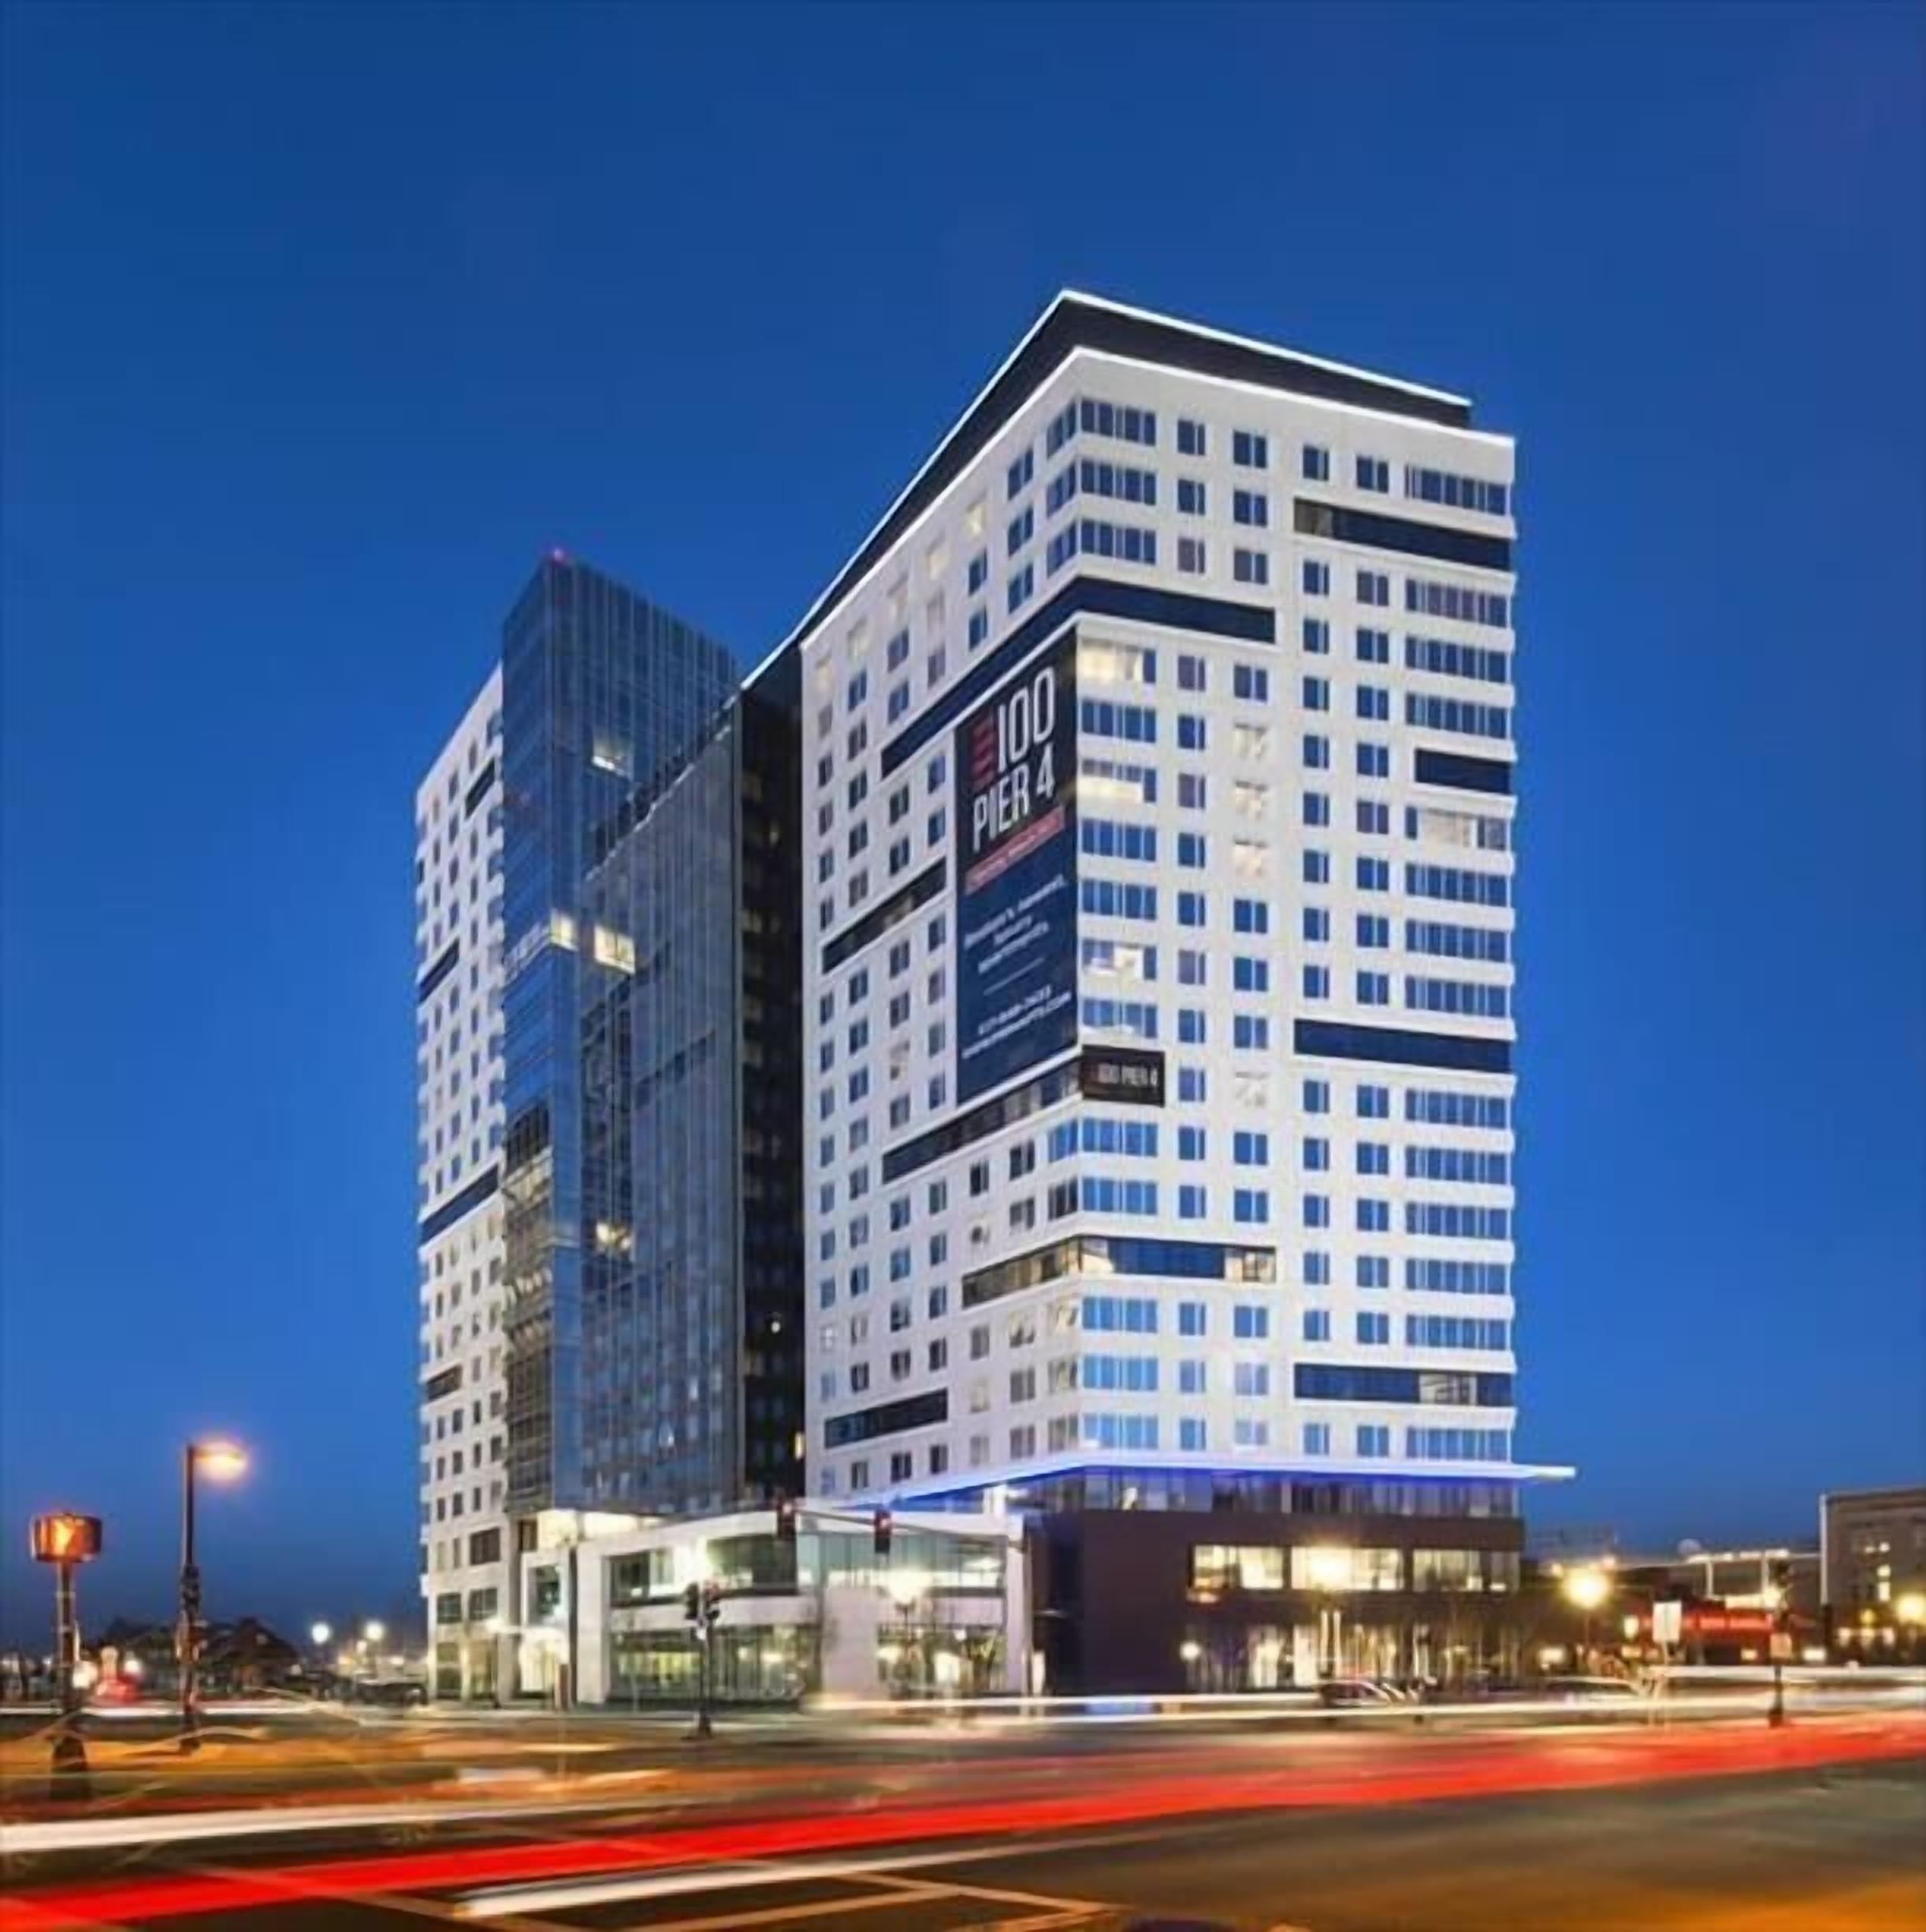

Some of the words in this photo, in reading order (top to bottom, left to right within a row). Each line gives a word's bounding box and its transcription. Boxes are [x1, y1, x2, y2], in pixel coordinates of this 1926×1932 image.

[997, 667, 1055, 775] 100
[972, 761, 1030, 851] PIER
[1036, 741, 1056, 798] 4
